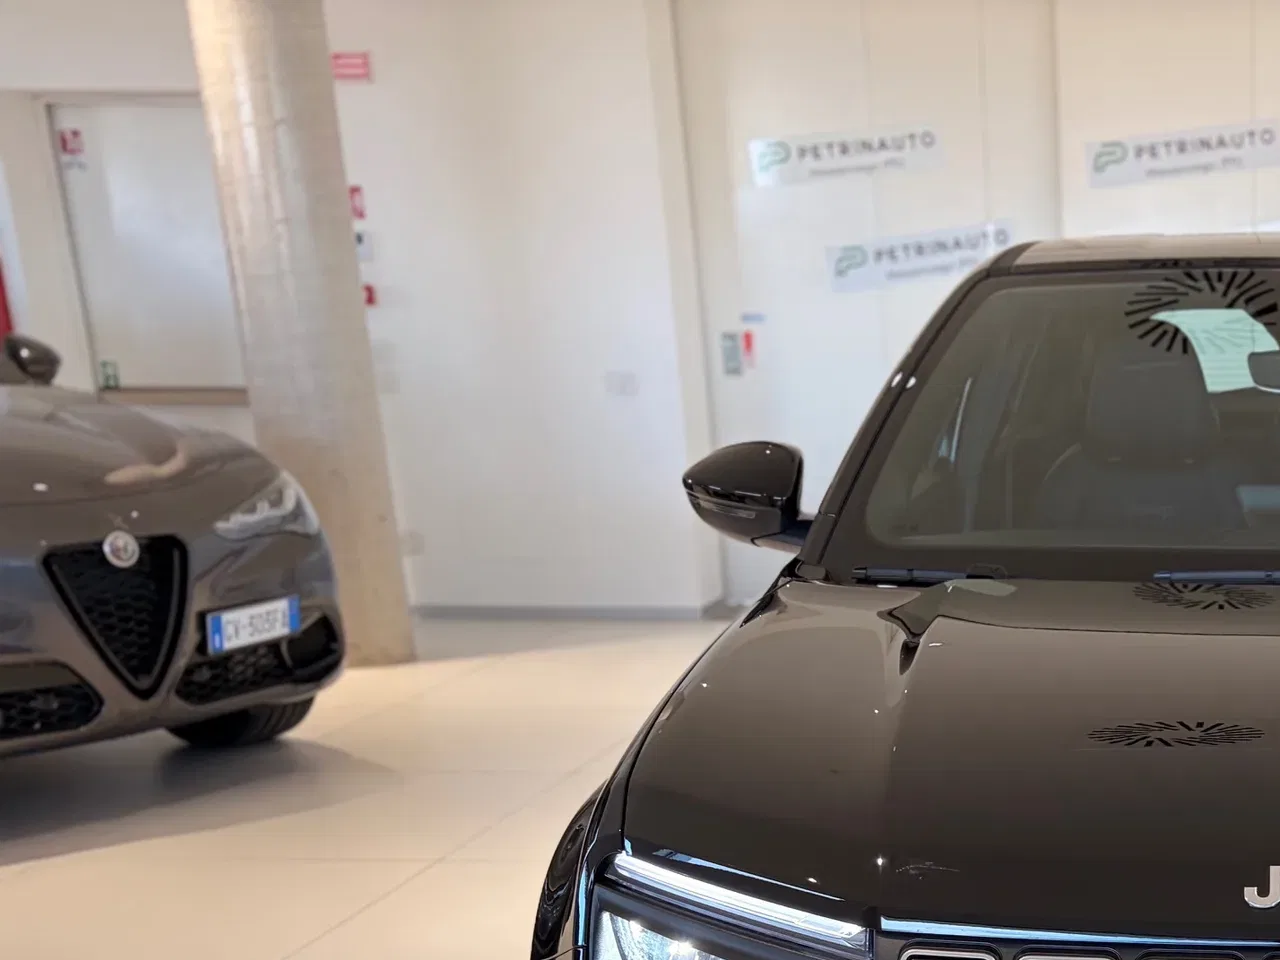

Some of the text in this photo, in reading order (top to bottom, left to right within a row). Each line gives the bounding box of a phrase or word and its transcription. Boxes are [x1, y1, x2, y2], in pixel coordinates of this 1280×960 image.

[796, 129, 936, 161] PETRINAUTO
[1134, 127, 1277, 161] PETRINAUTO
[873, 227, 1010, 265] PETRINAUTO
